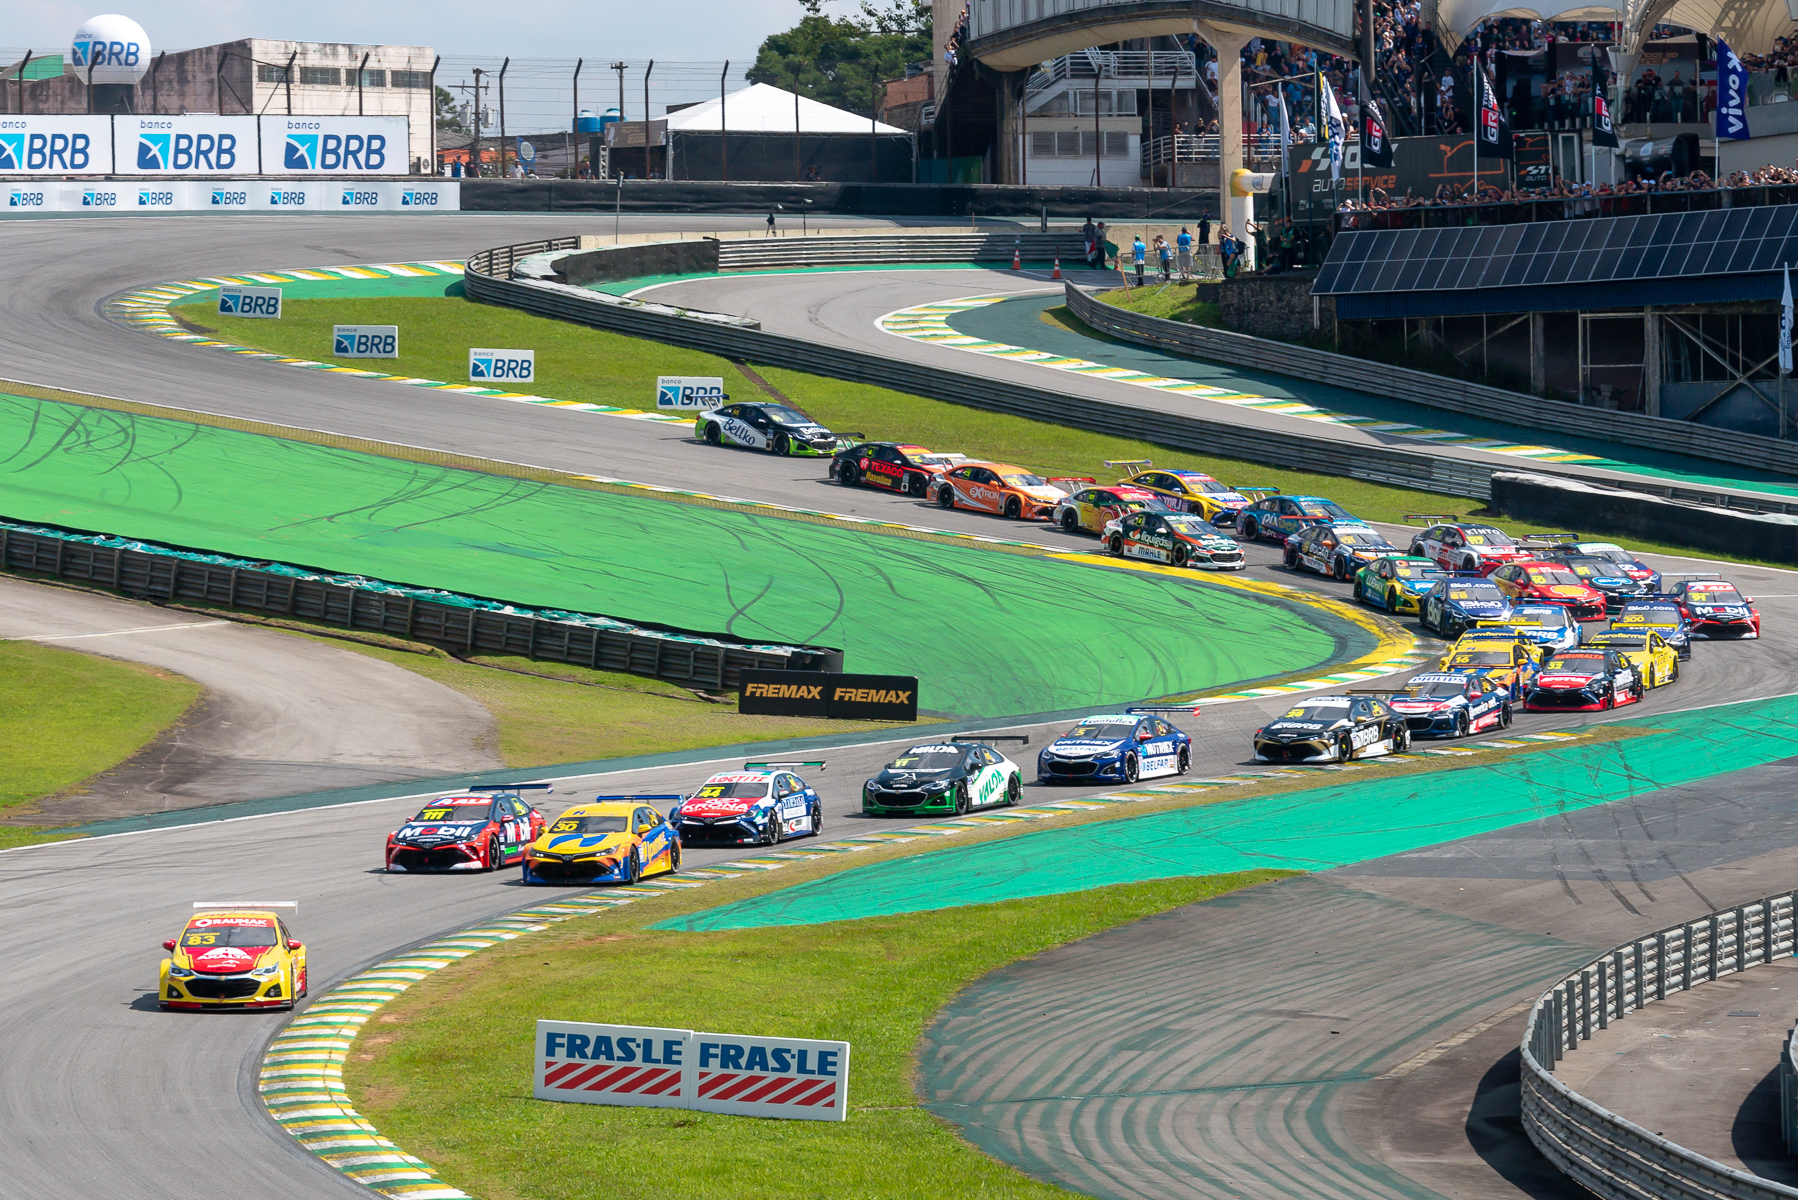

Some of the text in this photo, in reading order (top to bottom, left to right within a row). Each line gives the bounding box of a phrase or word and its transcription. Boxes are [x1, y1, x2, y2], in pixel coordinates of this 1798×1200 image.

[91, 41, 140, 66] BRB
[1721, 74, 1744, 134] vivo
[0, 120, 26, 128] anco
[140, 120, 172, 129] banco
[287, 120, 320, 130] banco
[1487, 112, 1498, 142] GR
[1371, 124, 1382, 151] GR
[27, 134, 90, 170] BRB
[172, 134, 236, 170] BRB
[320, 134, 386, 170] BRB
[22, 192, 44, 206] BRB
[95, 192, 116, 206] BRB
[150, 192, 173, 206] BRB
[224, 192, 246, 204] BRB
[282, 192, 305, 204] BRB
[354, 192, 378, 205] BRB
[414, 192, 438, 205] BRB
[240, 296, 278, 314] BRB
[356, 335, 396, 354] BRB
[492, 358, 532, 378] BRB
[681, 386, 722, 406] BRB
[723, 418, 756, 446] Bellko
[871, 461, 904, 478] TEXACO
[866, 471, 892, 486] Havoline
[1138, 546, 1162, 559] MAHLE
[744, 683, 912, 704] FREMAX FREMAX
[1362, 725, 1379, 746] BRB
[1145, 741, 1174, 756] NUTRIEX
[1146, 758, 1170, 771] BELFAR
[699, 789, 722, 798] 44
[682, 803, 748, 812] KRONA
[423, 811, 446, 820] 111
[398, 826, 472, 838] Mobil
[552, 823, 578, 832] 30
[188, 936, 216, 946] 83
